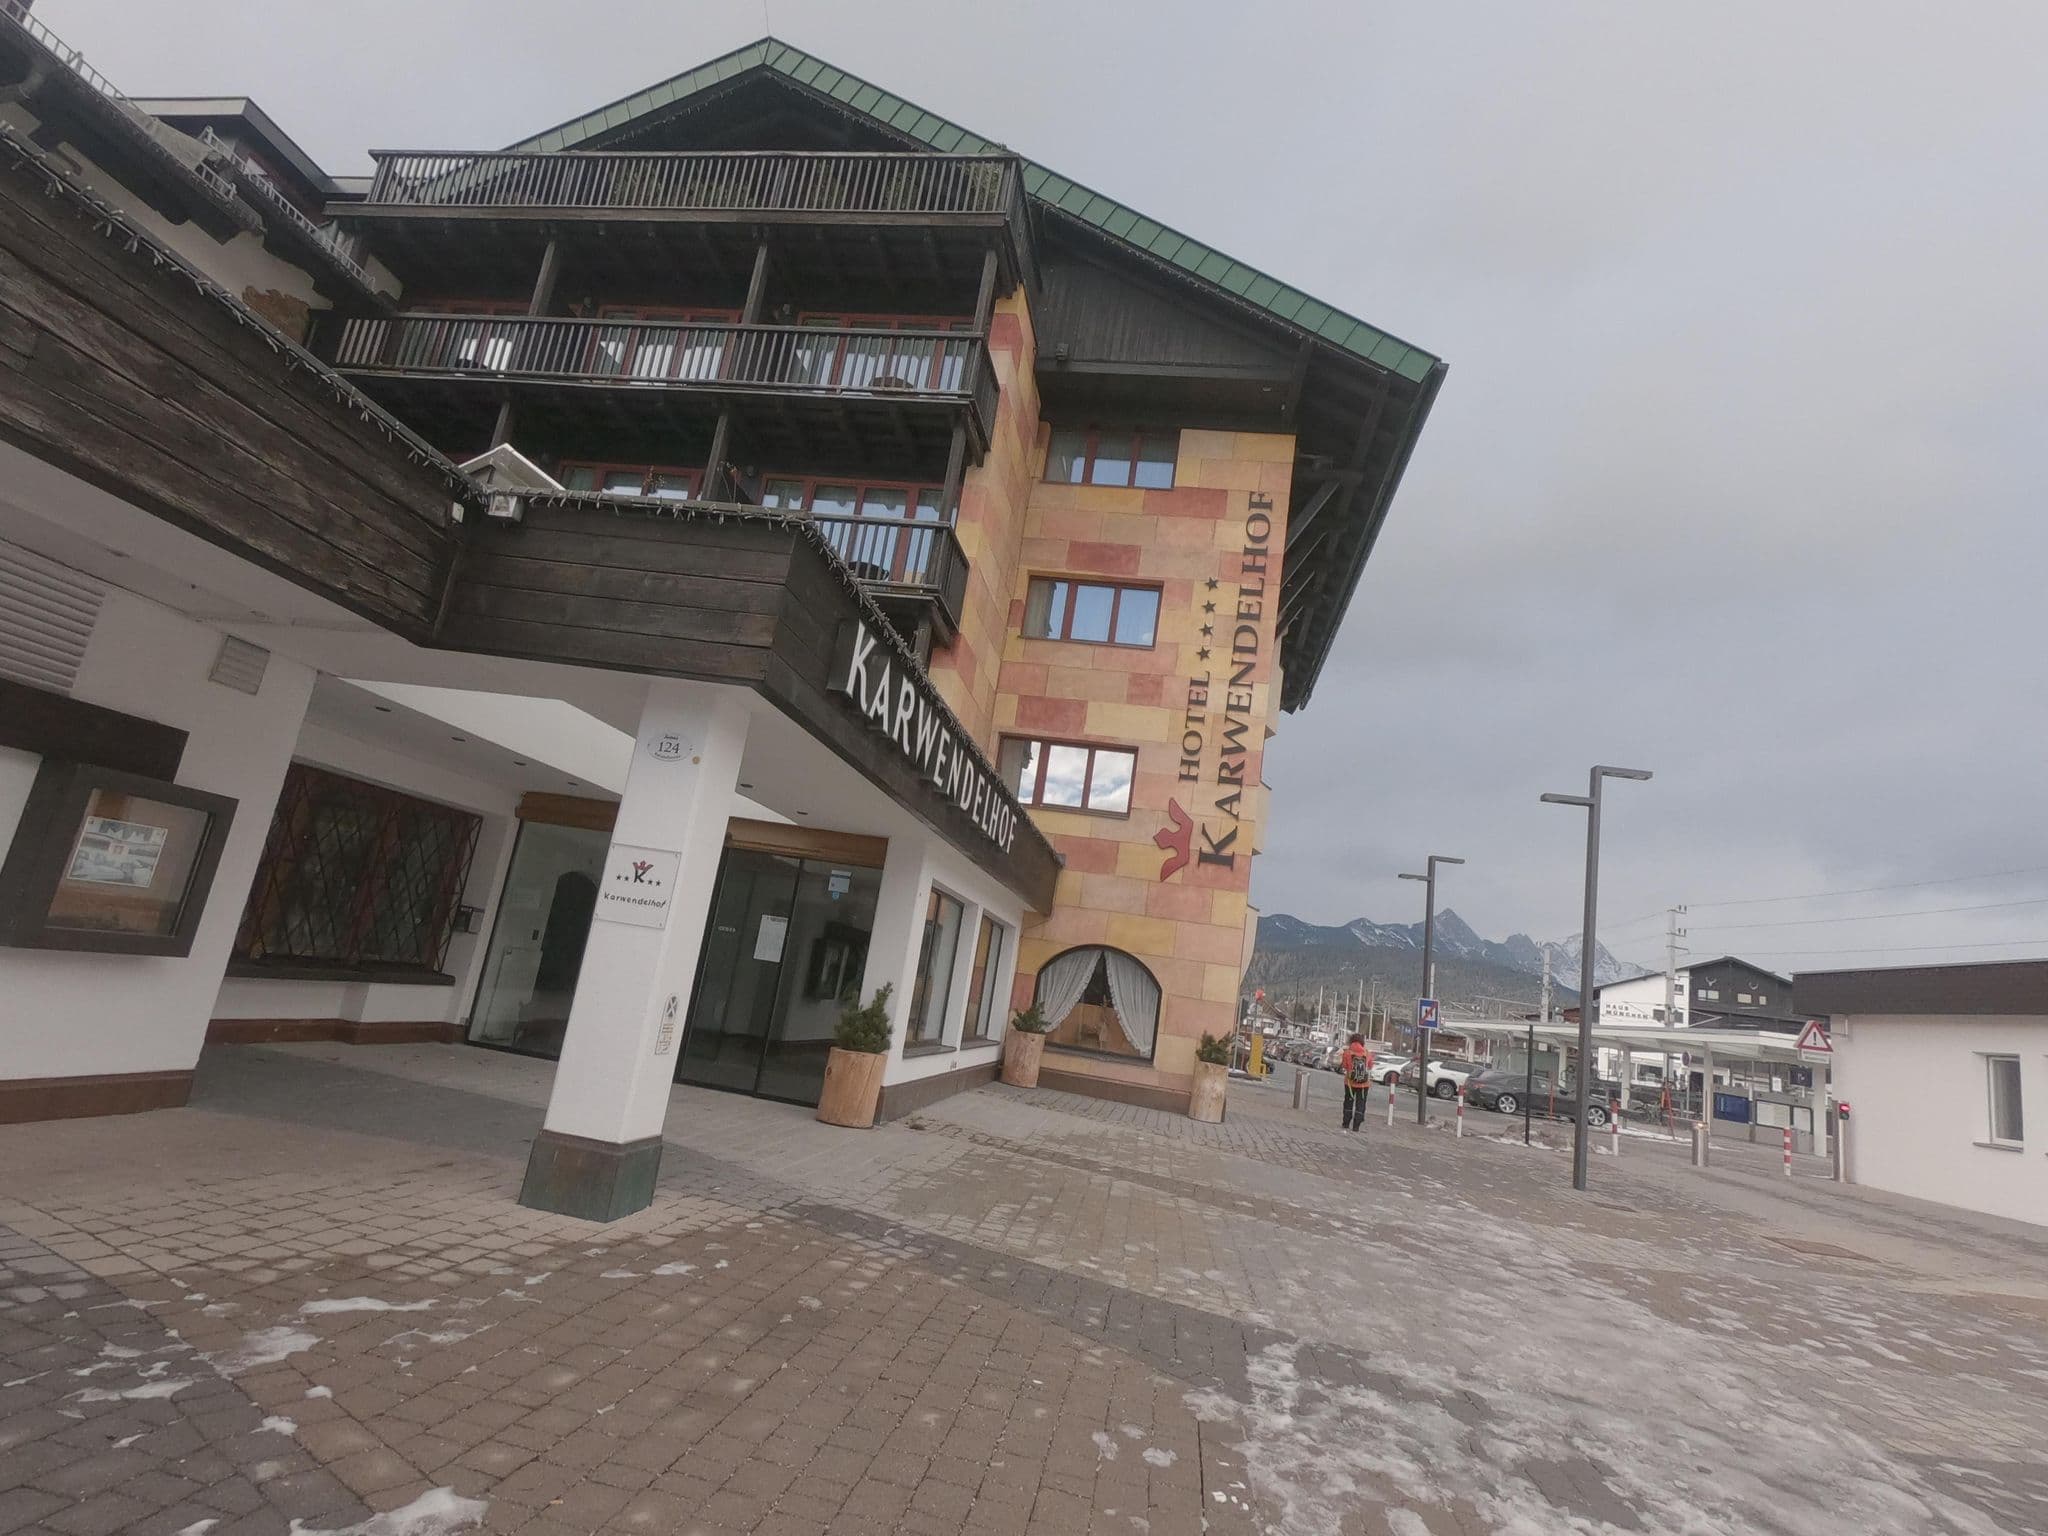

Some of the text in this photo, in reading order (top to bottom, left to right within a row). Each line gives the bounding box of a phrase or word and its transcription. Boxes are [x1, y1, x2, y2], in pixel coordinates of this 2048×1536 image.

[658, 742, 680, 754] 124
[845, 619, 1018, 854] KARWENDELHOF
[1178, 670, 1210, 783] HOTEL
[1198, 491, 1274, 871] KARWENDELHOF
